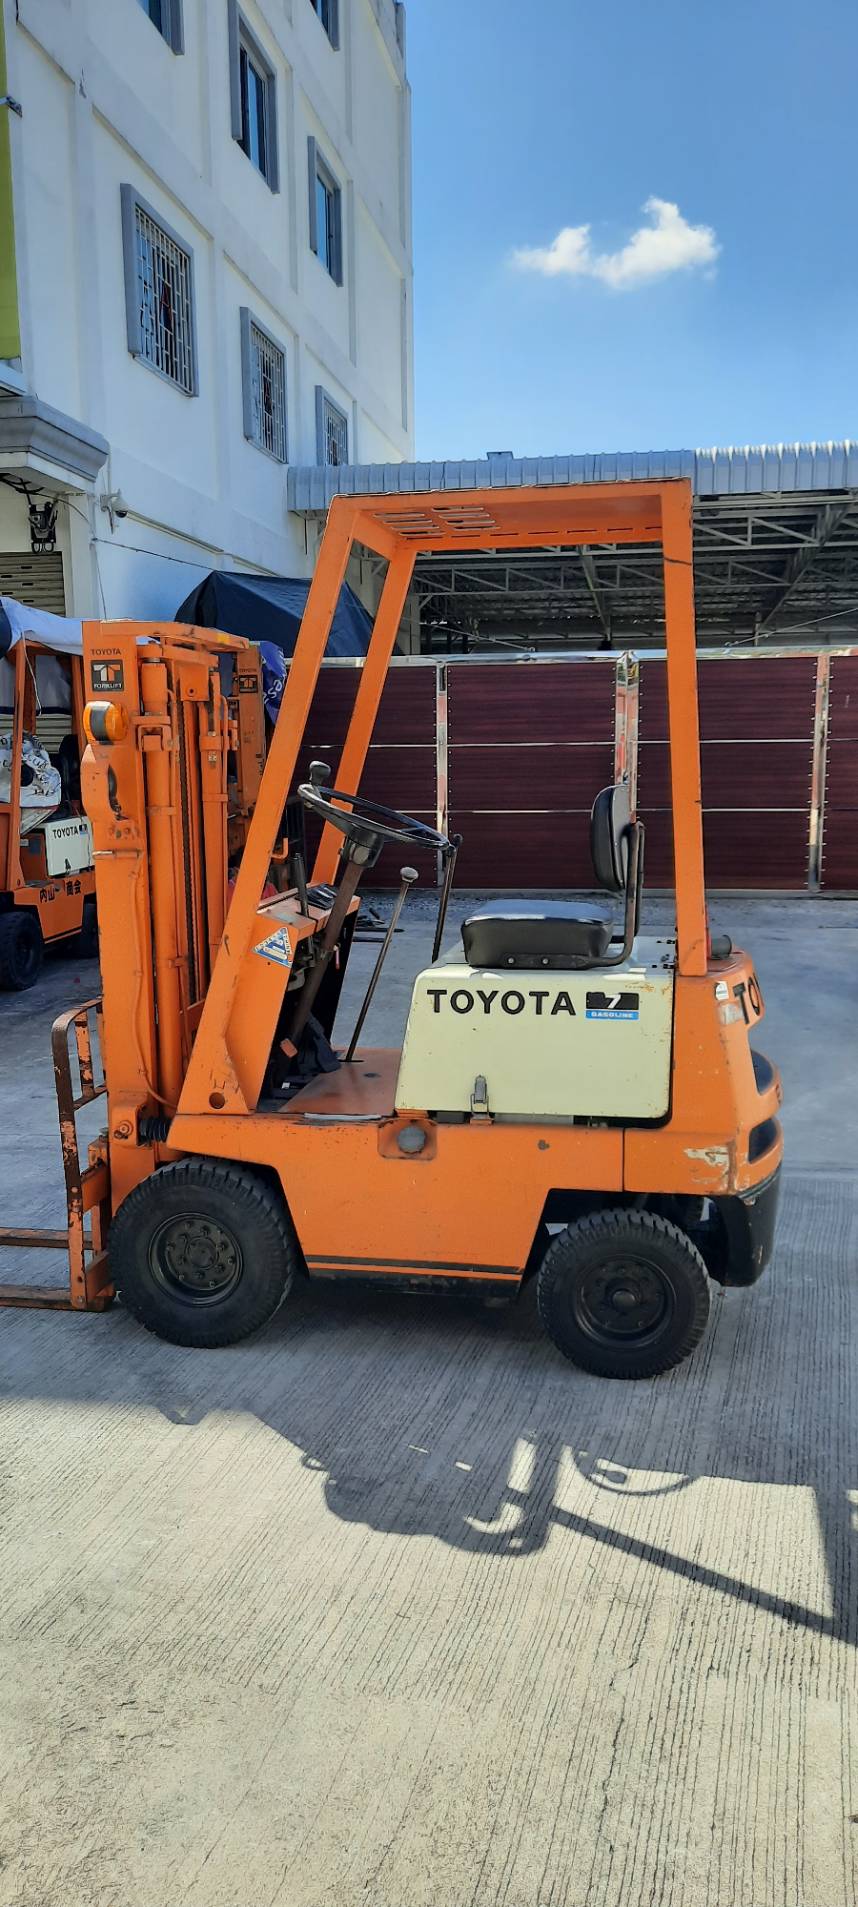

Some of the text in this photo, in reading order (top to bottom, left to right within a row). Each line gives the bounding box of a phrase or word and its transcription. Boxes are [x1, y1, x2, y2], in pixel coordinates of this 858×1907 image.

[90, 648, 122, 656] TOYOTA
[53, 826, 78, 840] TOYOTA
[427, 989, 576, 1016] TOYOTA
[604, 993, 622, 1009] 7
